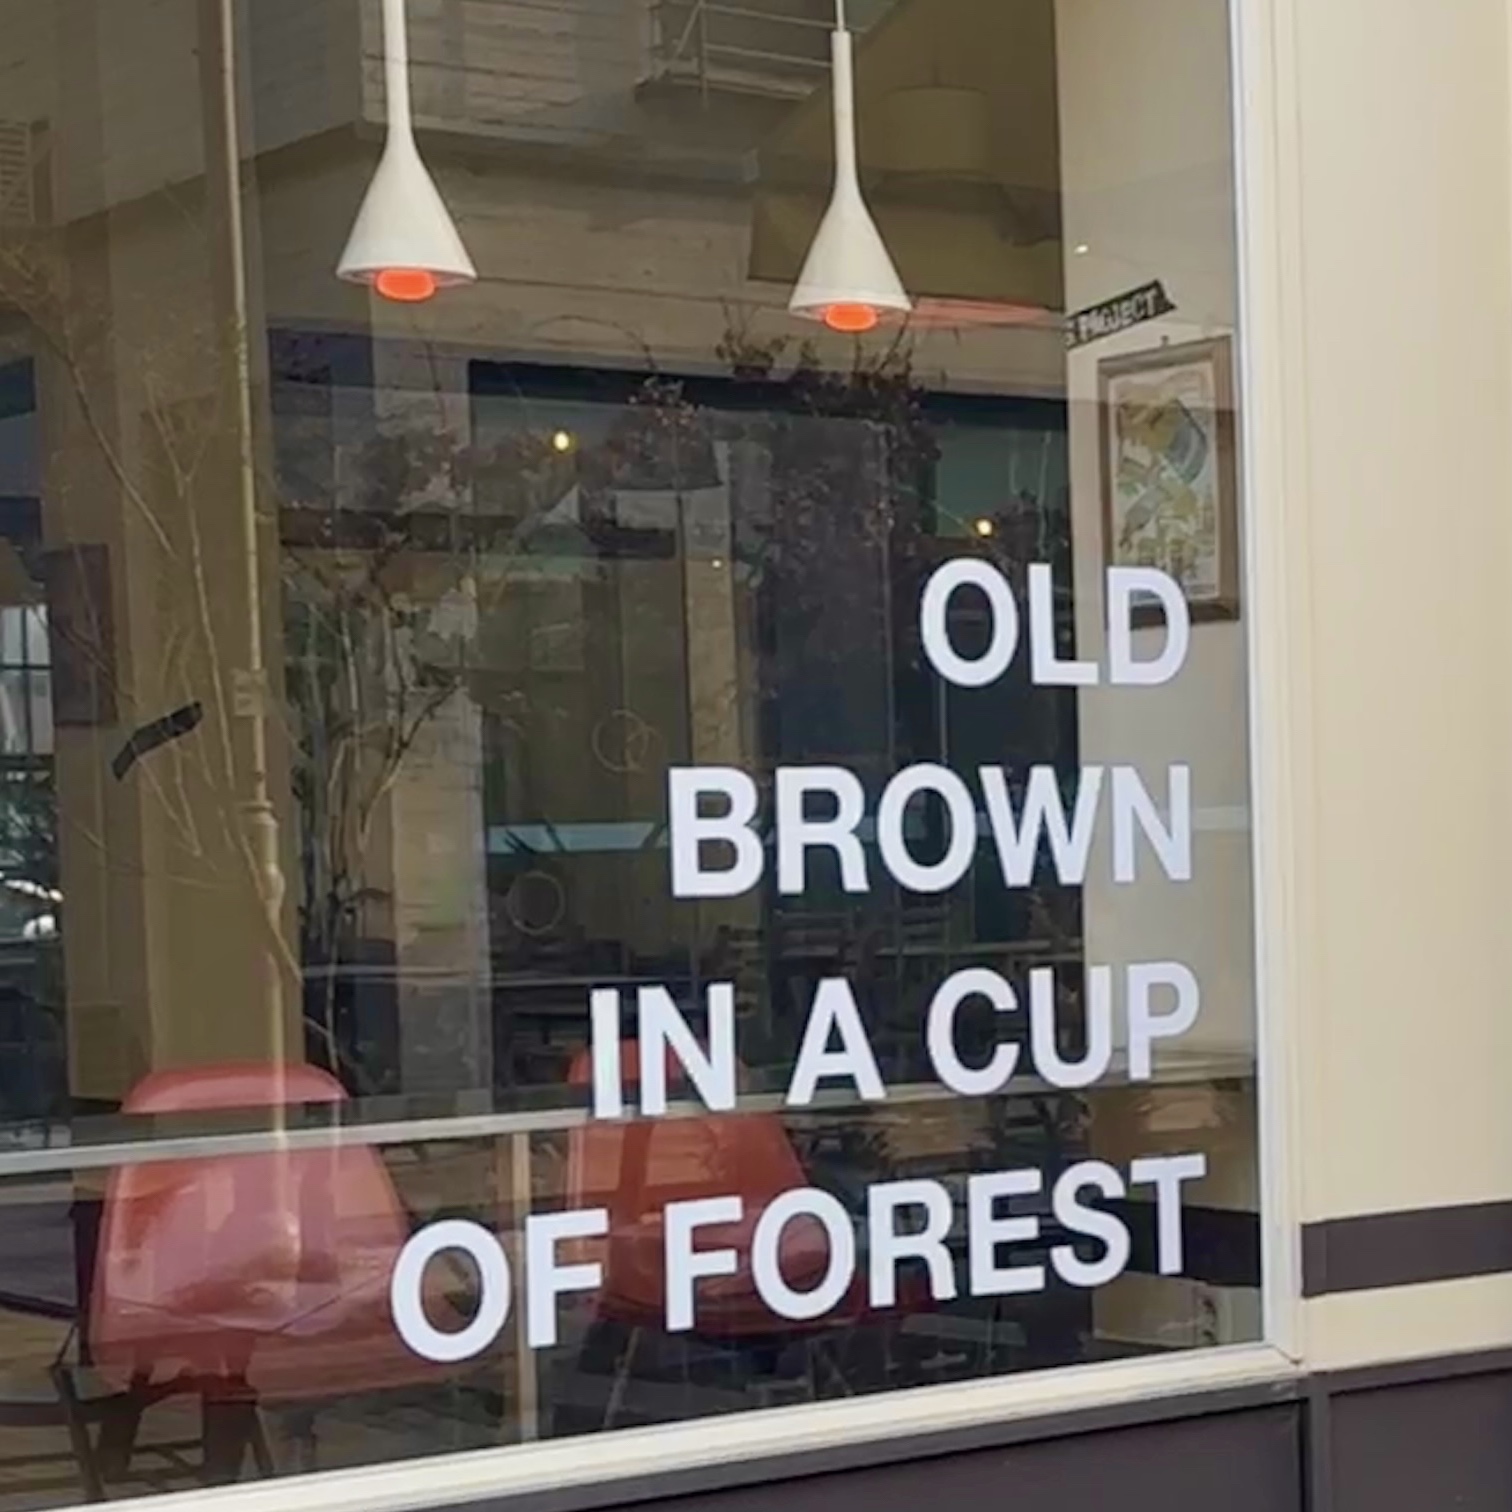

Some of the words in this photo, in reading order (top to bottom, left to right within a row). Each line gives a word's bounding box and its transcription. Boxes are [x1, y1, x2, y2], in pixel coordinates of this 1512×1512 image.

[921, 558, 1191, 687] OLD
[668, 763, 1193, 897] BROWN
[589, 983, 737, 1119] IN
[786, 978, 887, 1105] A
[927, 961, 1201, 1096] CUP
[390, 1208, 609, 1362] OF
[664, 1154, 1206, 1332] FOREST
